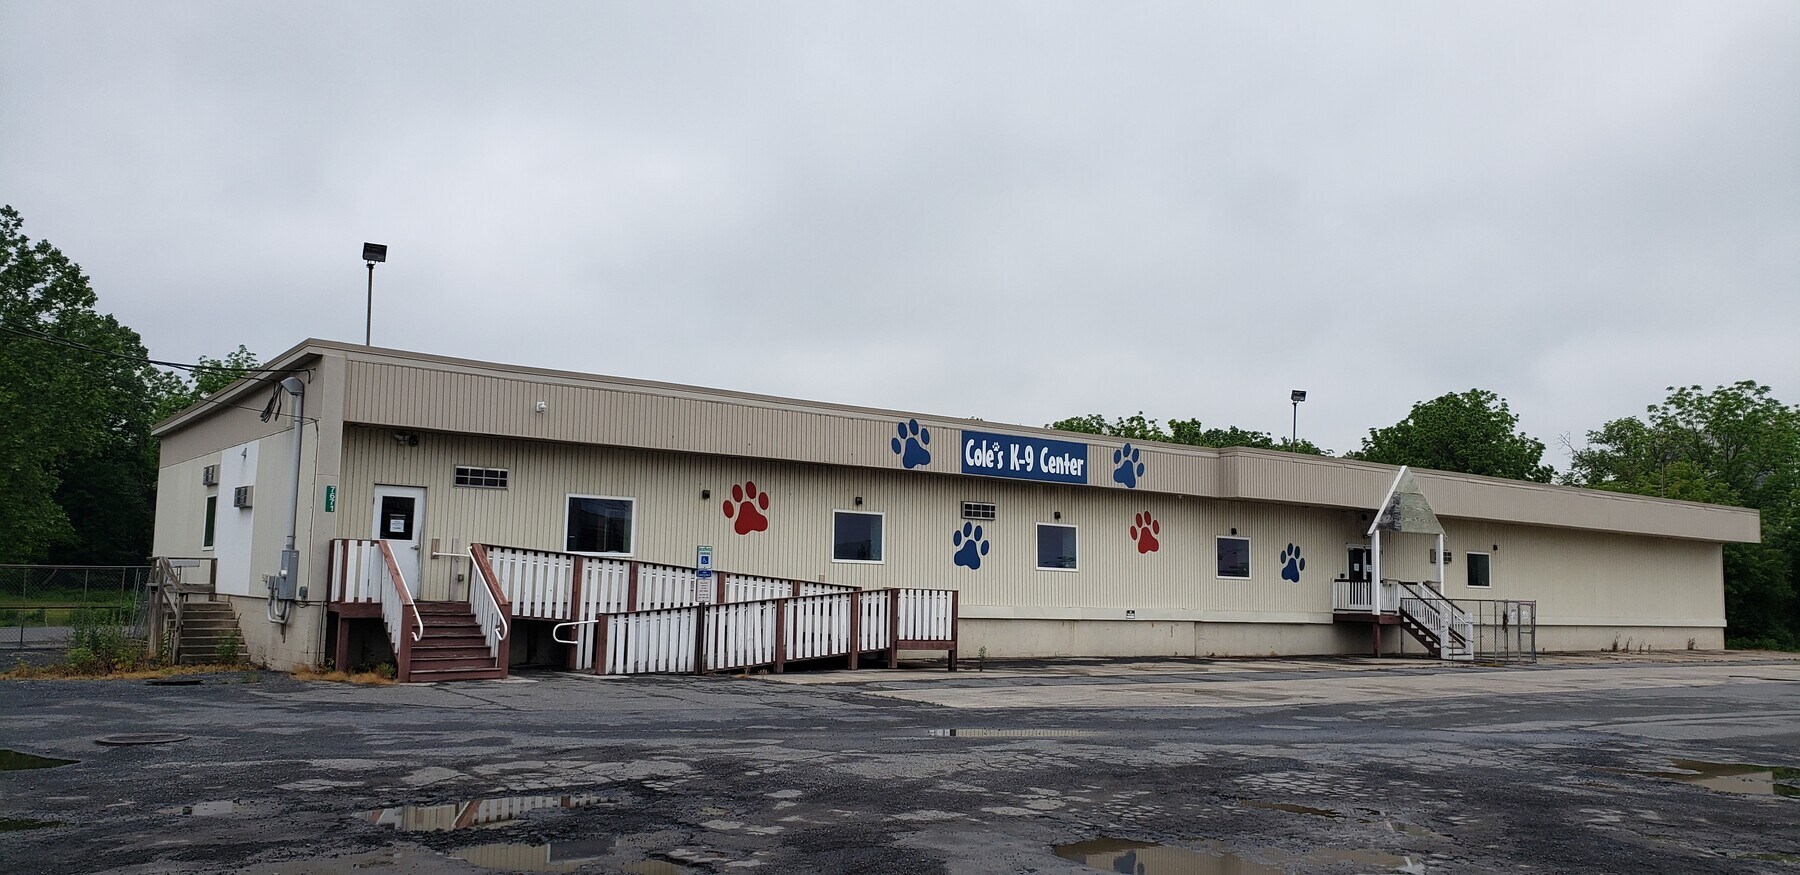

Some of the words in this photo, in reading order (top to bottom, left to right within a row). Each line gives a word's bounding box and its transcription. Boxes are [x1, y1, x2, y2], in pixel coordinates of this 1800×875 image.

[965, 439, 1004, 470] Cole's
[1010, 443, 1034, 472] K-9
[1040, 446, 1084, 476] Center
